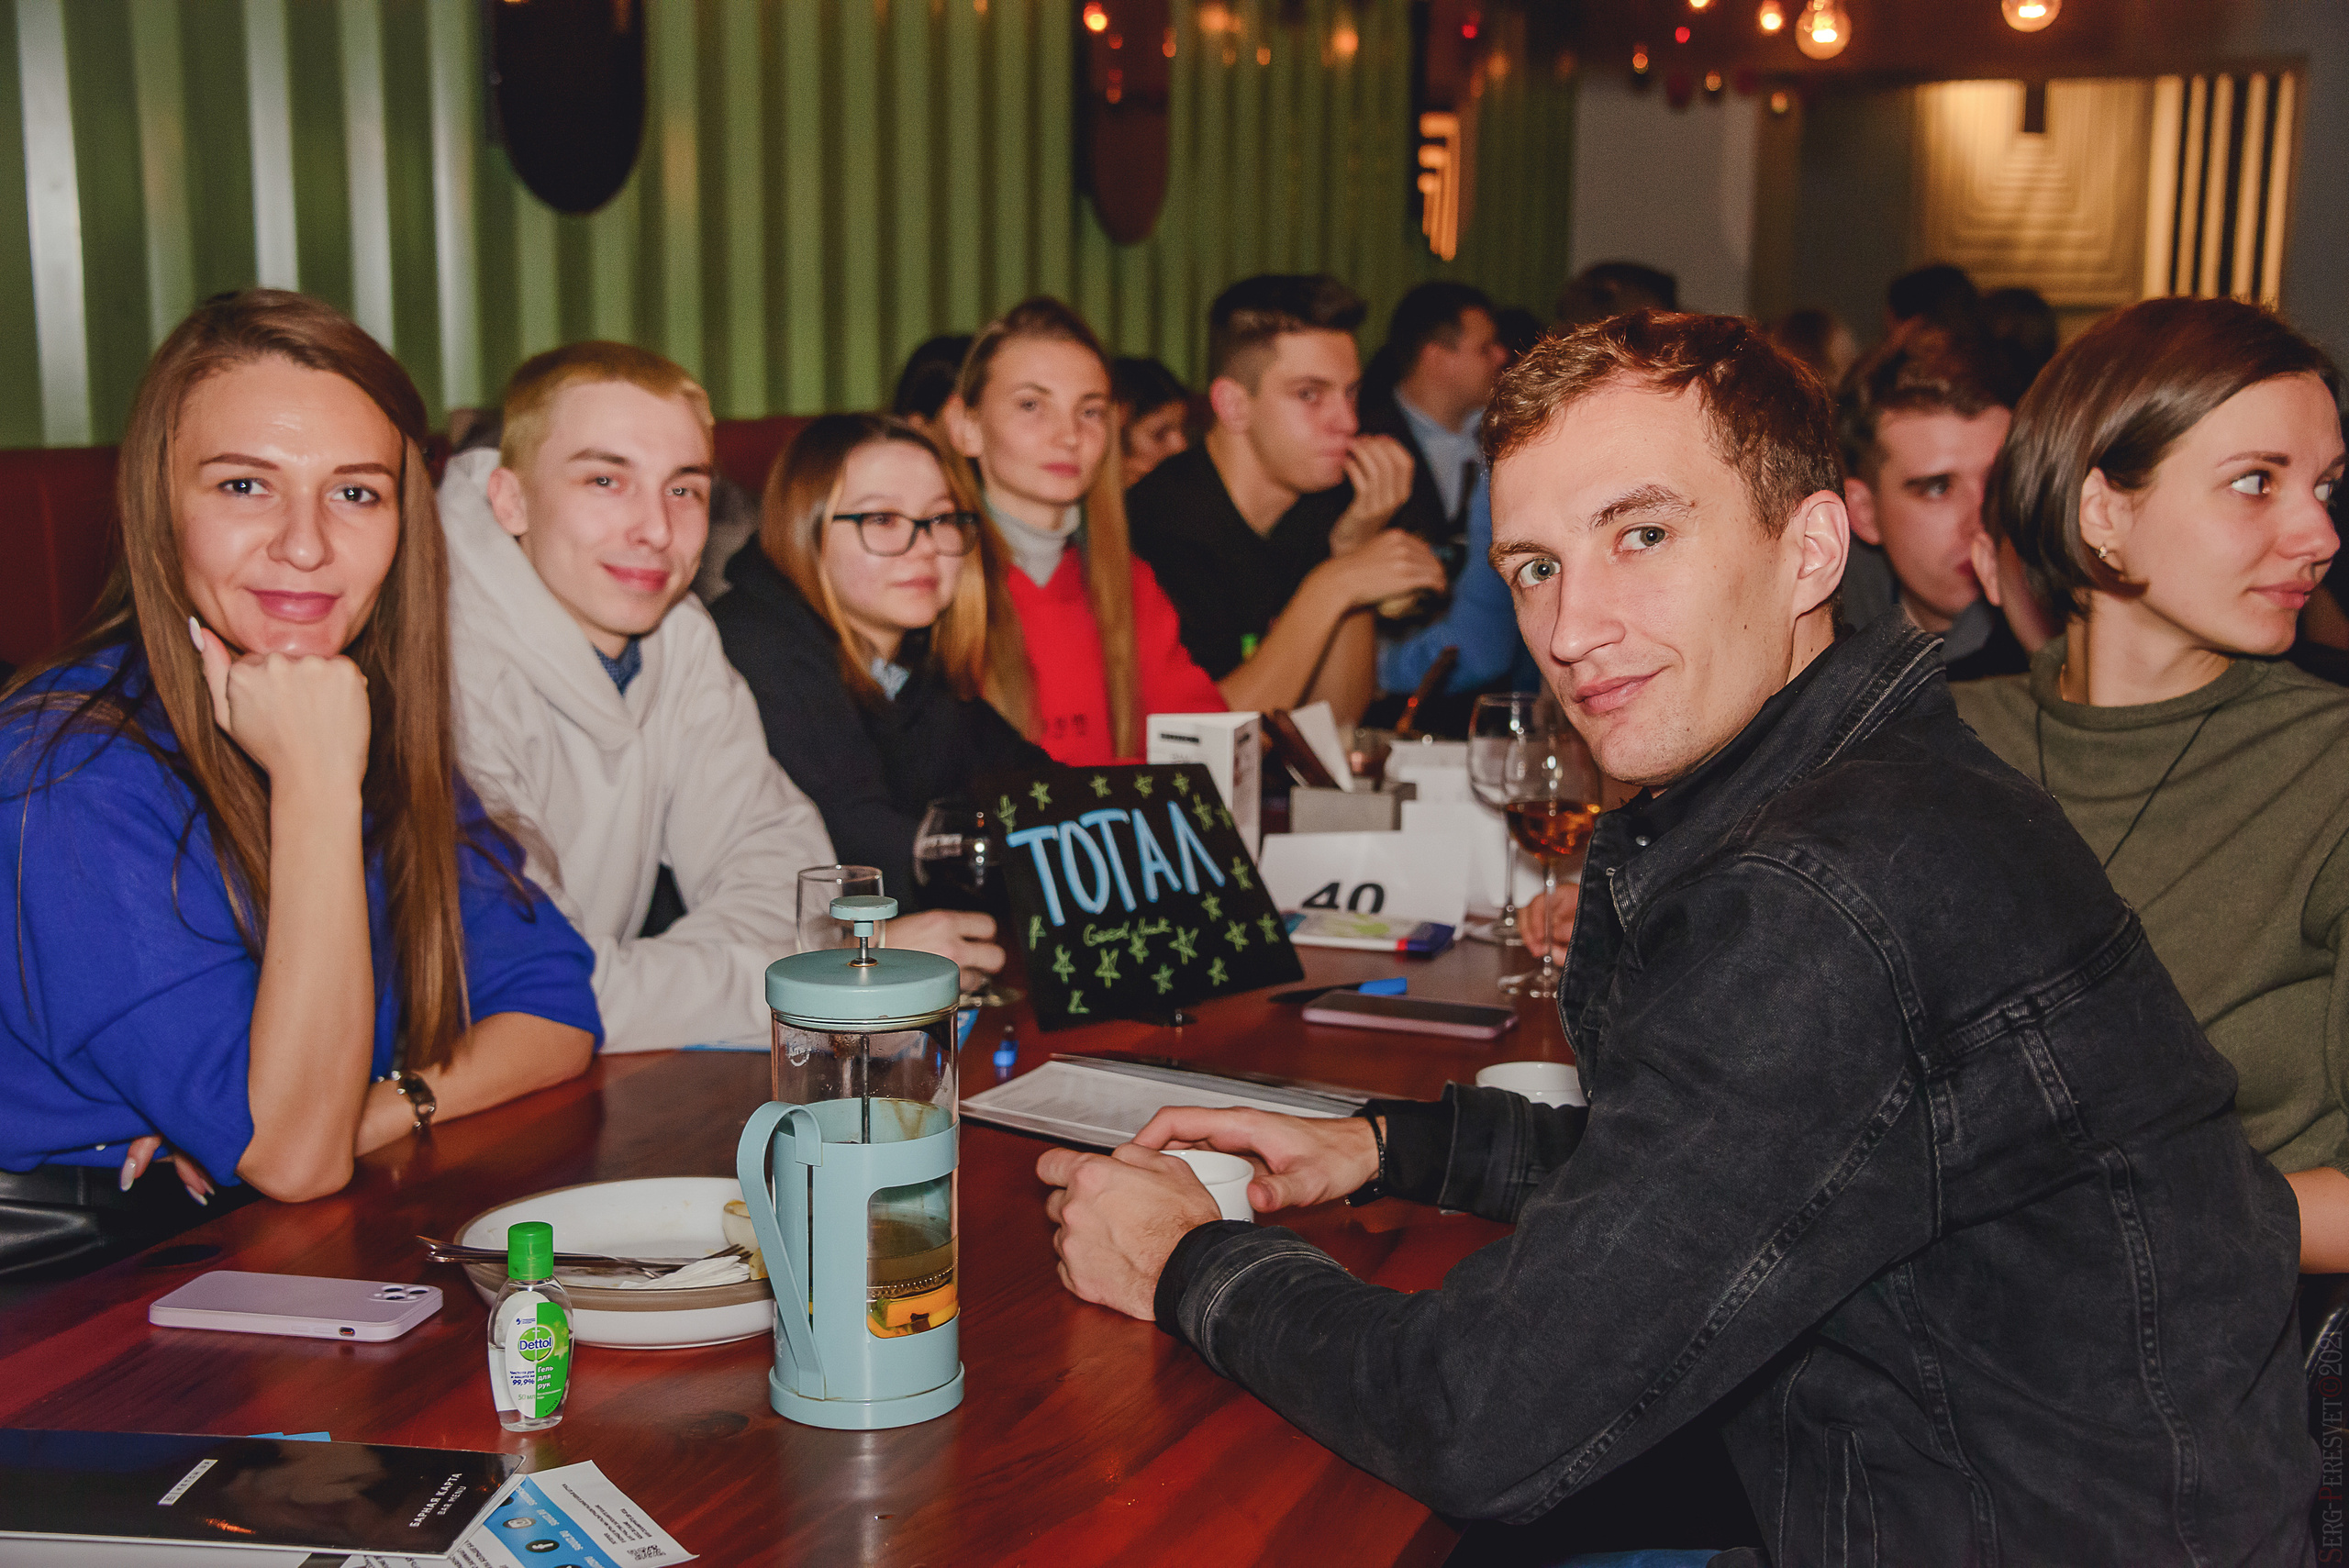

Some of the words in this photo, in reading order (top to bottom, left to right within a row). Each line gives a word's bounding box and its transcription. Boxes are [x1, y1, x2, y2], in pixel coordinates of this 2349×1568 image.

[1006, 800, 1226, 927] ТОТАЛ
[1302, 883, 1385, 914] 40
[519, 1337, 551, 1351] Dettol
[512, 1378, 535, 1386] 99,9%
[538, 1373, 551, 1382] для
[538, 1382, 551, 1390] рук
[409, 1497, 441, 1528] БАРНАЯ
[435, 1473, 462, 1496] КАРТА
